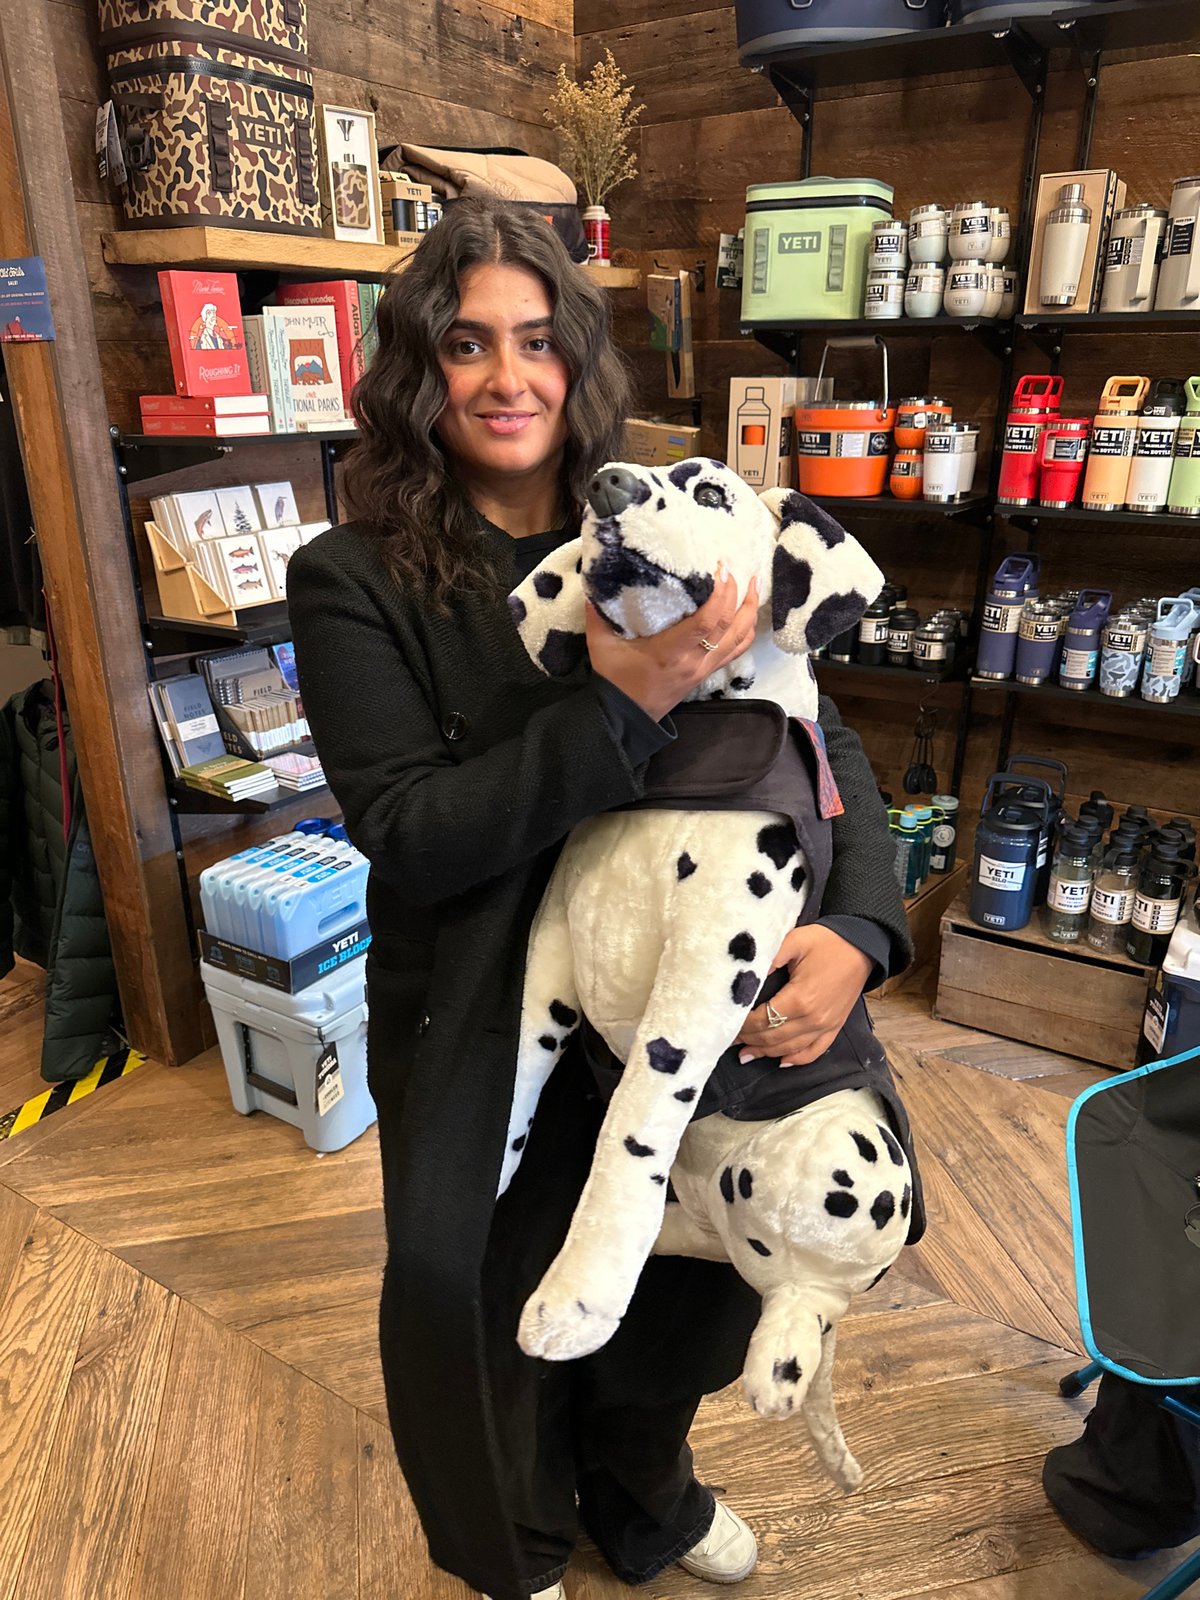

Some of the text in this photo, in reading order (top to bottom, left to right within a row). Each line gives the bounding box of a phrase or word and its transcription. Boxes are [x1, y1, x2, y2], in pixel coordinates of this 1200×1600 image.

[242, 122, 282, 145] YETI
[406, 187, 422, 196] YETI
[965, 217, 986, 226] YETI
[782, 235, 818, 250] YETI
[877, 236, 898, 245] YETI
[955, 274, 977, 283] YETI
[285, 316, 301, 327] OHN
[293, 397, 340, 412] TIONAL PARKS
[801, 433, 820, 444] YETI
[1007, 427, 1034, 439] YETI
[1093, 429, 1124, 442] YETI
[1141, 431, 1174, 443] YETI
[928, 437, 950, 445] YETI
[984, 606, 1001, 619] ETI
[1036, 624, 1058, 633] YETI
[1109, 632, 1132, 643] YETI
[253, 686, 272, 697] FIELD
[184, 703, 202, 713] FIELD
[184, 709, 206, 719] NOTES
[223, 732, 238, 743] ELD
[987, 866, 1015, 879] YETI
[991, 876, 1007, 884] SILO
[1060, 884, 1089, 896] YETI
[985, 915, 1004, 924] YETI
[332, 931, 359, 953] YETI
[318, 954, 339, 975] ICE
